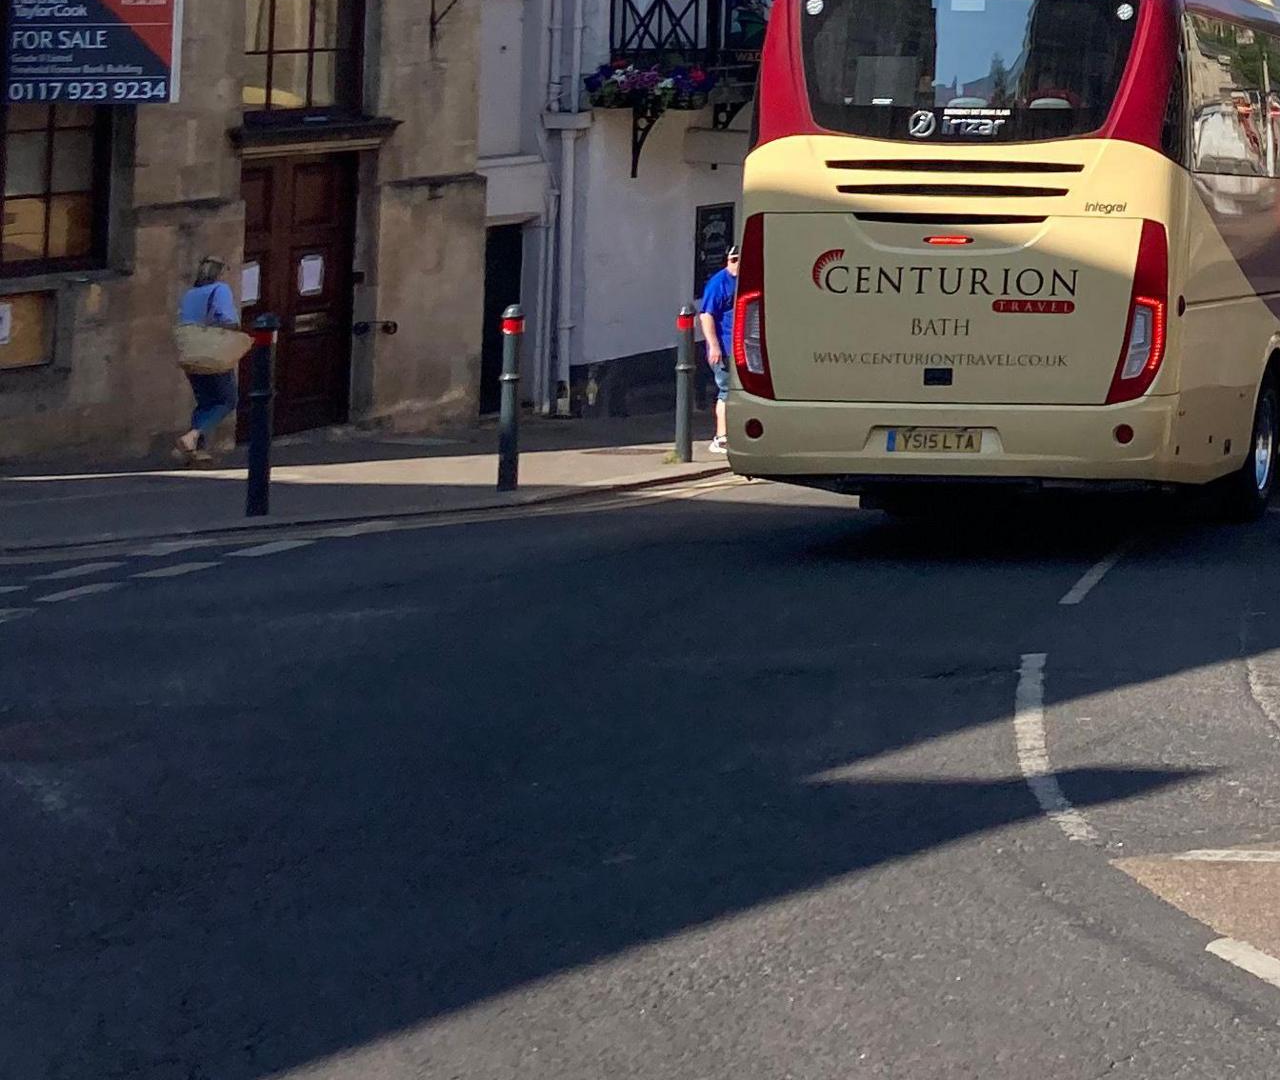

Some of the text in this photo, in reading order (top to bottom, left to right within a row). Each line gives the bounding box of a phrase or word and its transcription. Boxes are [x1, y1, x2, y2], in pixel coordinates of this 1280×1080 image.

[12, 30, 109, 49] FOR SALE
[9, 81, 166, 101] 0117 923 9234
[1084, 201, 1127, 214] Integral
[824, 265, 1079, 297] CENTURION
[998, 300, 1072, 314] TRAVEL
[911, 318, 970, 337] BATH
[812, 351, 1068, 368] WWW.CENTURIONTRAVEL.CO.UK
[901, 433, 975, 450] YS15 LTA
